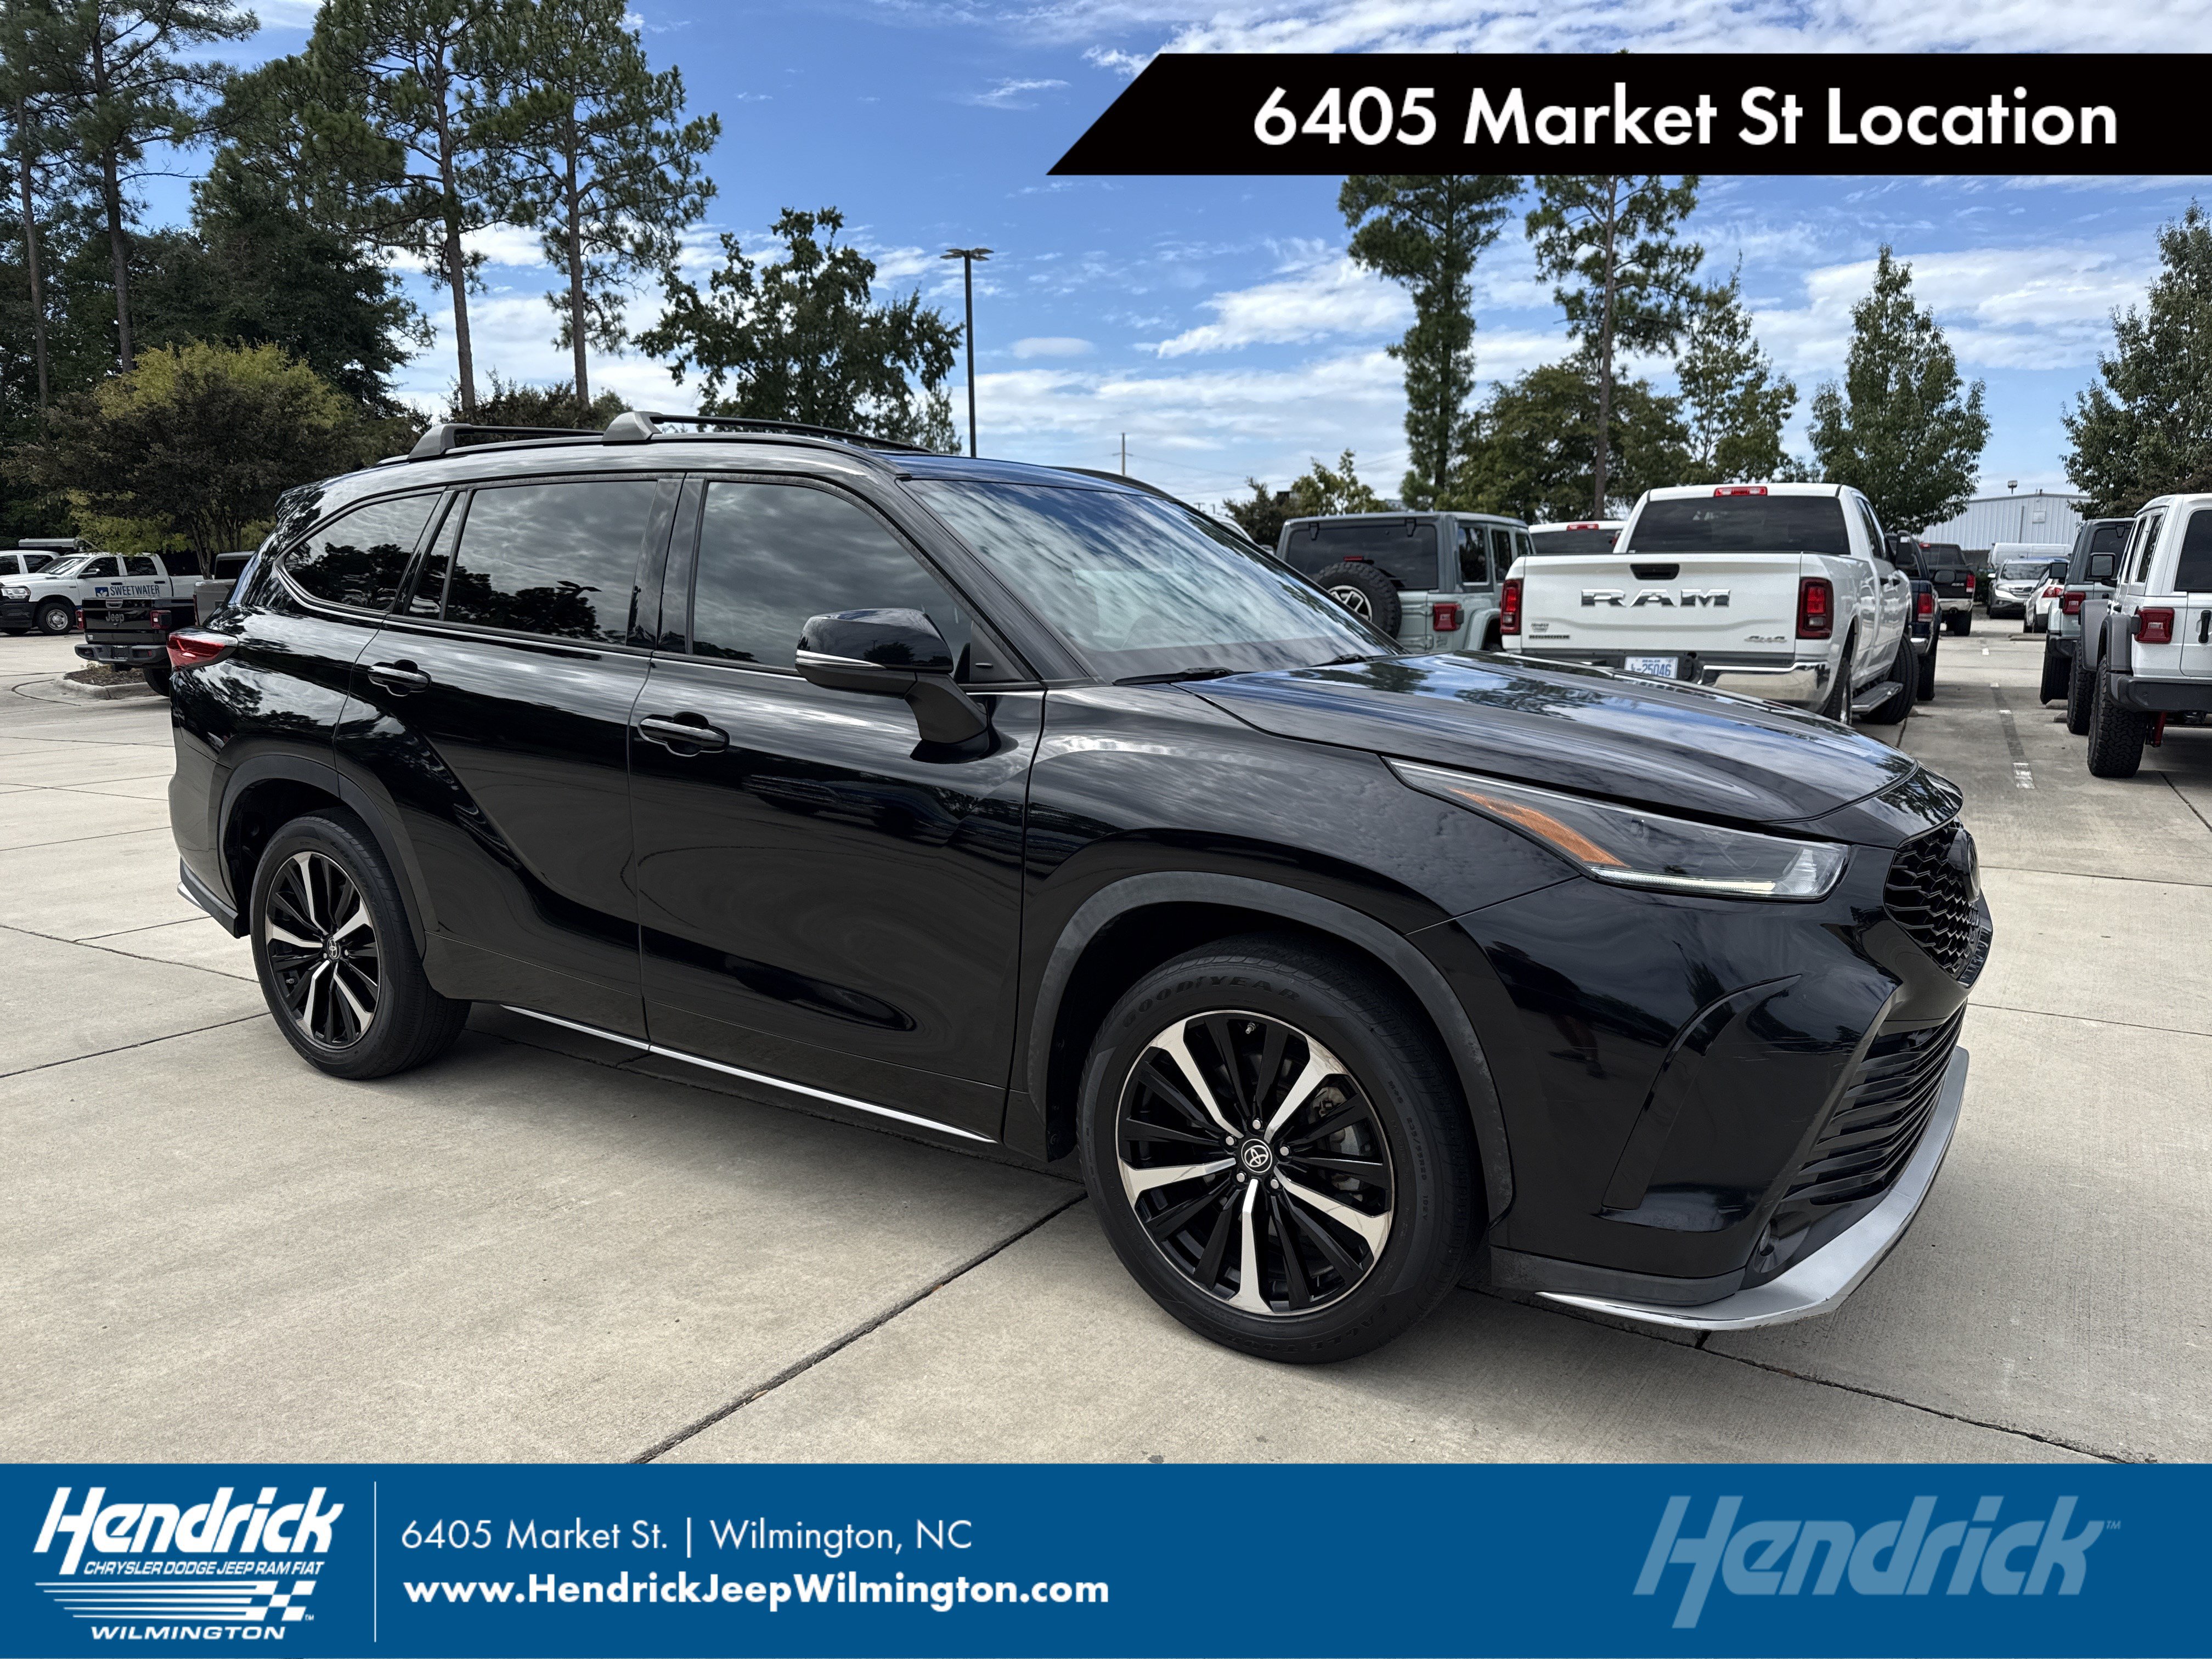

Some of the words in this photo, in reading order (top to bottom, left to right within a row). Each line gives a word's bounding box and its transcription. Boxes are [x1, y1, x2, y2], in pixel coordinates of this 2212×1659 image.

[110, 585, 160, 596] SWEETWATER
[1581, 589, 1730, 607] RAM
[106, 611, 125, 623] Jeep
[1123, 975, 1301, 1029] GOODYEAR
[1310, 1302, 1387, 1352] EAGLE
